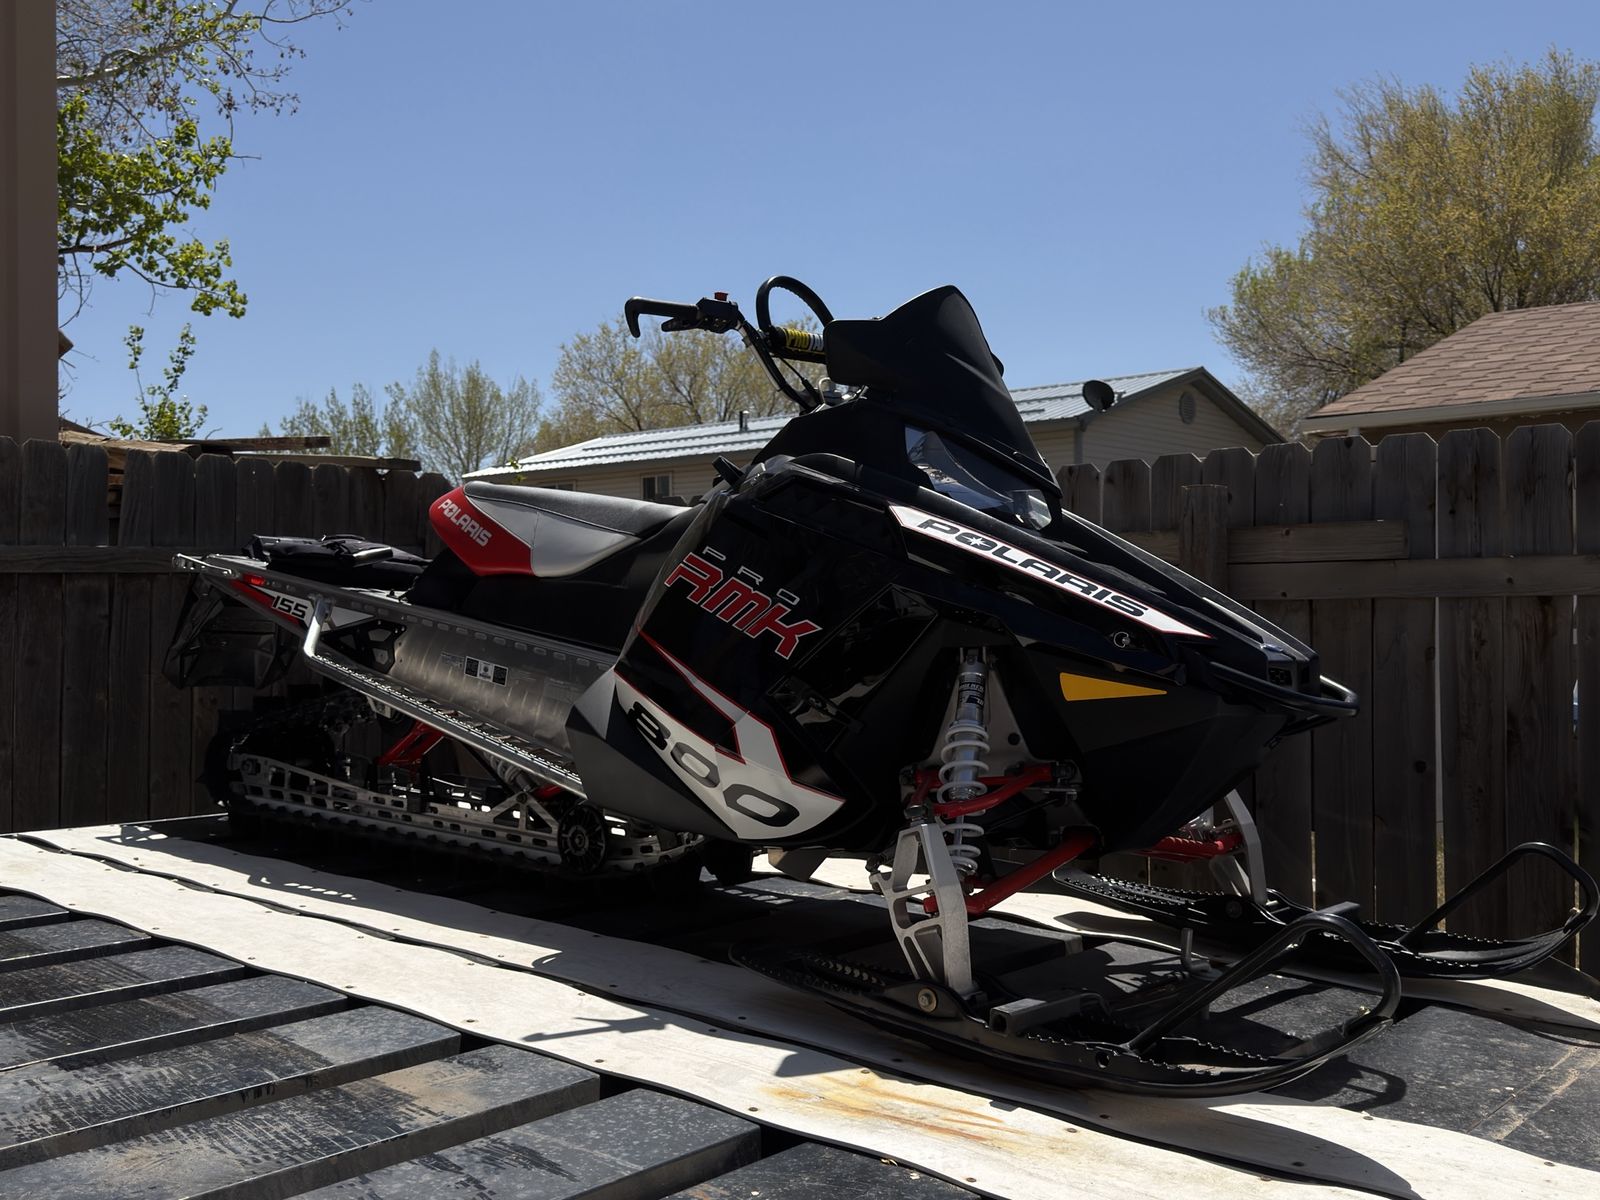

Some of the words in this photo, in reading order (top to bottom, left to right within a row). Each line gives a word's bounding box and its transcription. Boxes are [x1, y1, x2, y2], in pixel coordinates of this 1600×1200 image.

[437, 498, 493, 547] POLARIS
[272, 595, 309, 619] 155
[664, 552, 823, 660] RMK
[702, 546, 800, 606] PRO
[917, 518, 1150, 618] POLARIS
[627, 701, 800, 828] 800
